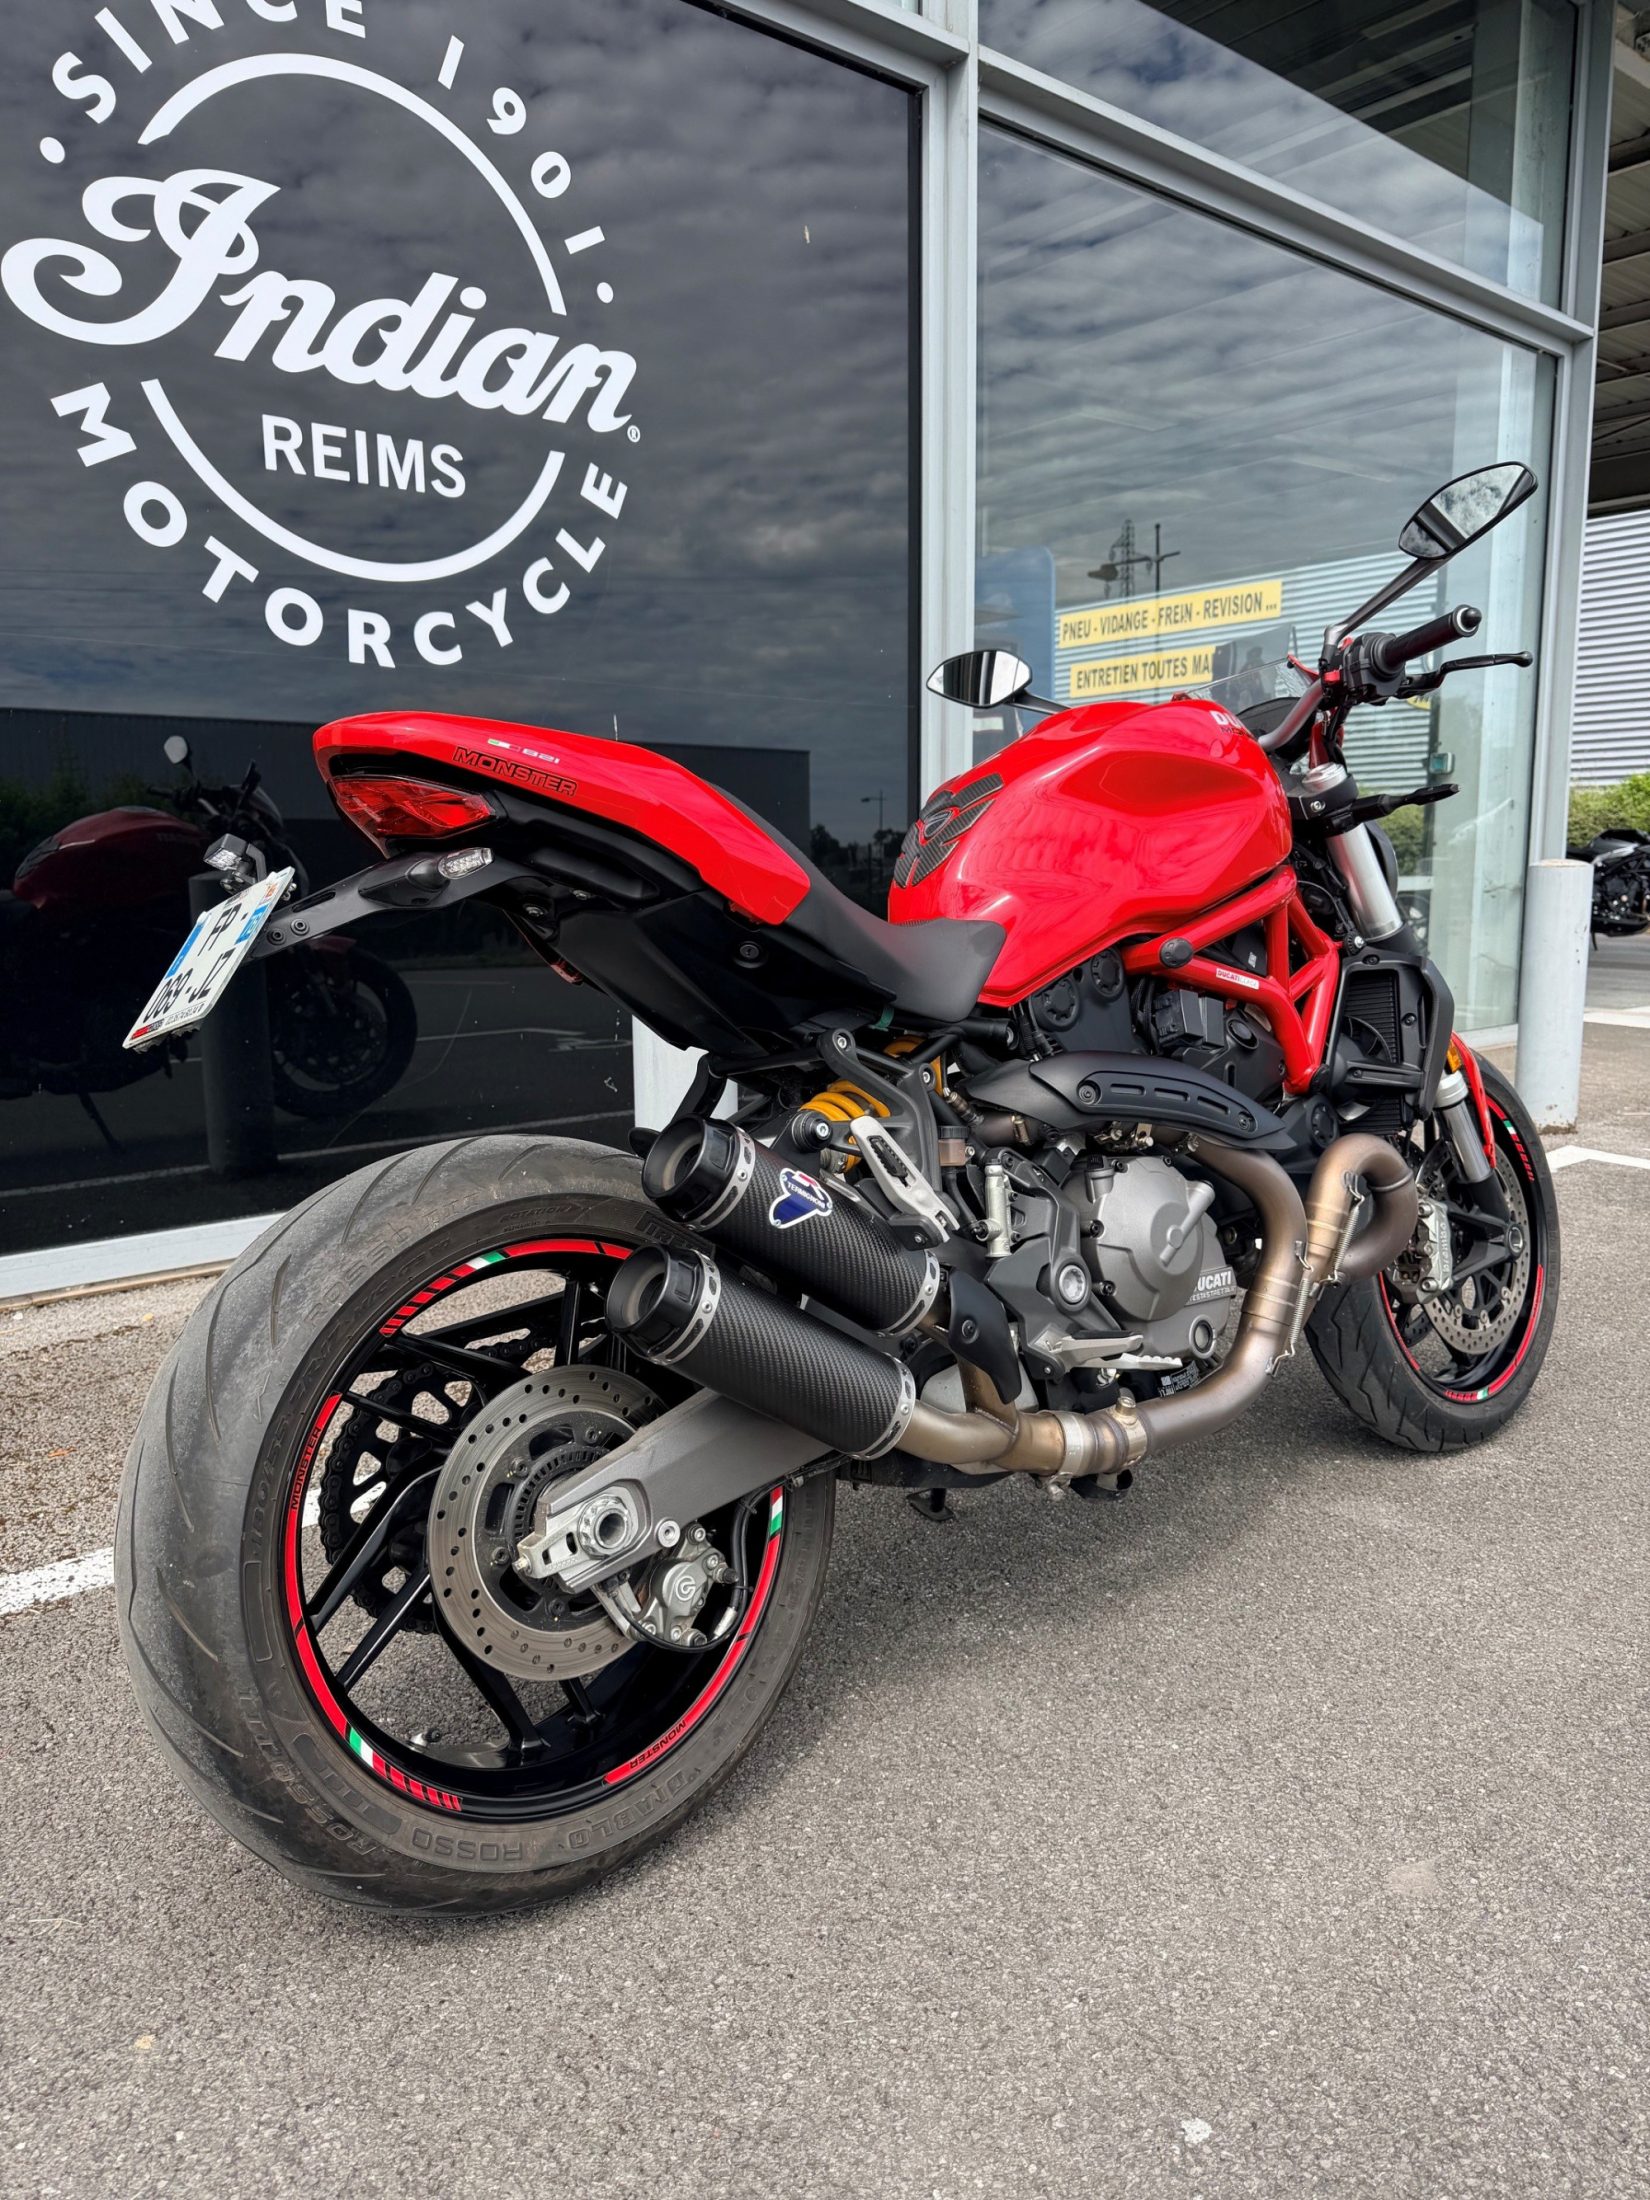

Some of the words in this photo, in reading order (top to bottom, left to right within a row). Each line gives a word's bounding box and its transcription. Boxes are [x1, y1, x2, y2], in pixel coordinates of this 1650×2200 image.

[1, 168, 637, 433] Indian
[261, 414, 467, 498] REIMS
[50, 382, 627, 668] MOTORCYCLE
[1062, 618, 1092, 642] PNEU
[1099, 609, 1149, 635] VIDANGE
[1158, 602, 1193, 627] FREIN
[1203, 592, 1263, 619] REVISION
[1076, 662, 1138, 690] ENTRETIEN
[1142, 656, 1187, 681] TOUTES
[1192, 653, 1210, 675] MA
[453, 746, 577, 797] MONSTER
[1193, 1270, 1232, 1293] UCATI
[289, 1427, 322, 1511] MONSTER
[628, 1719, 687, 1771] MONSTER
[410, 1826, 524, 1863] ROSSO
